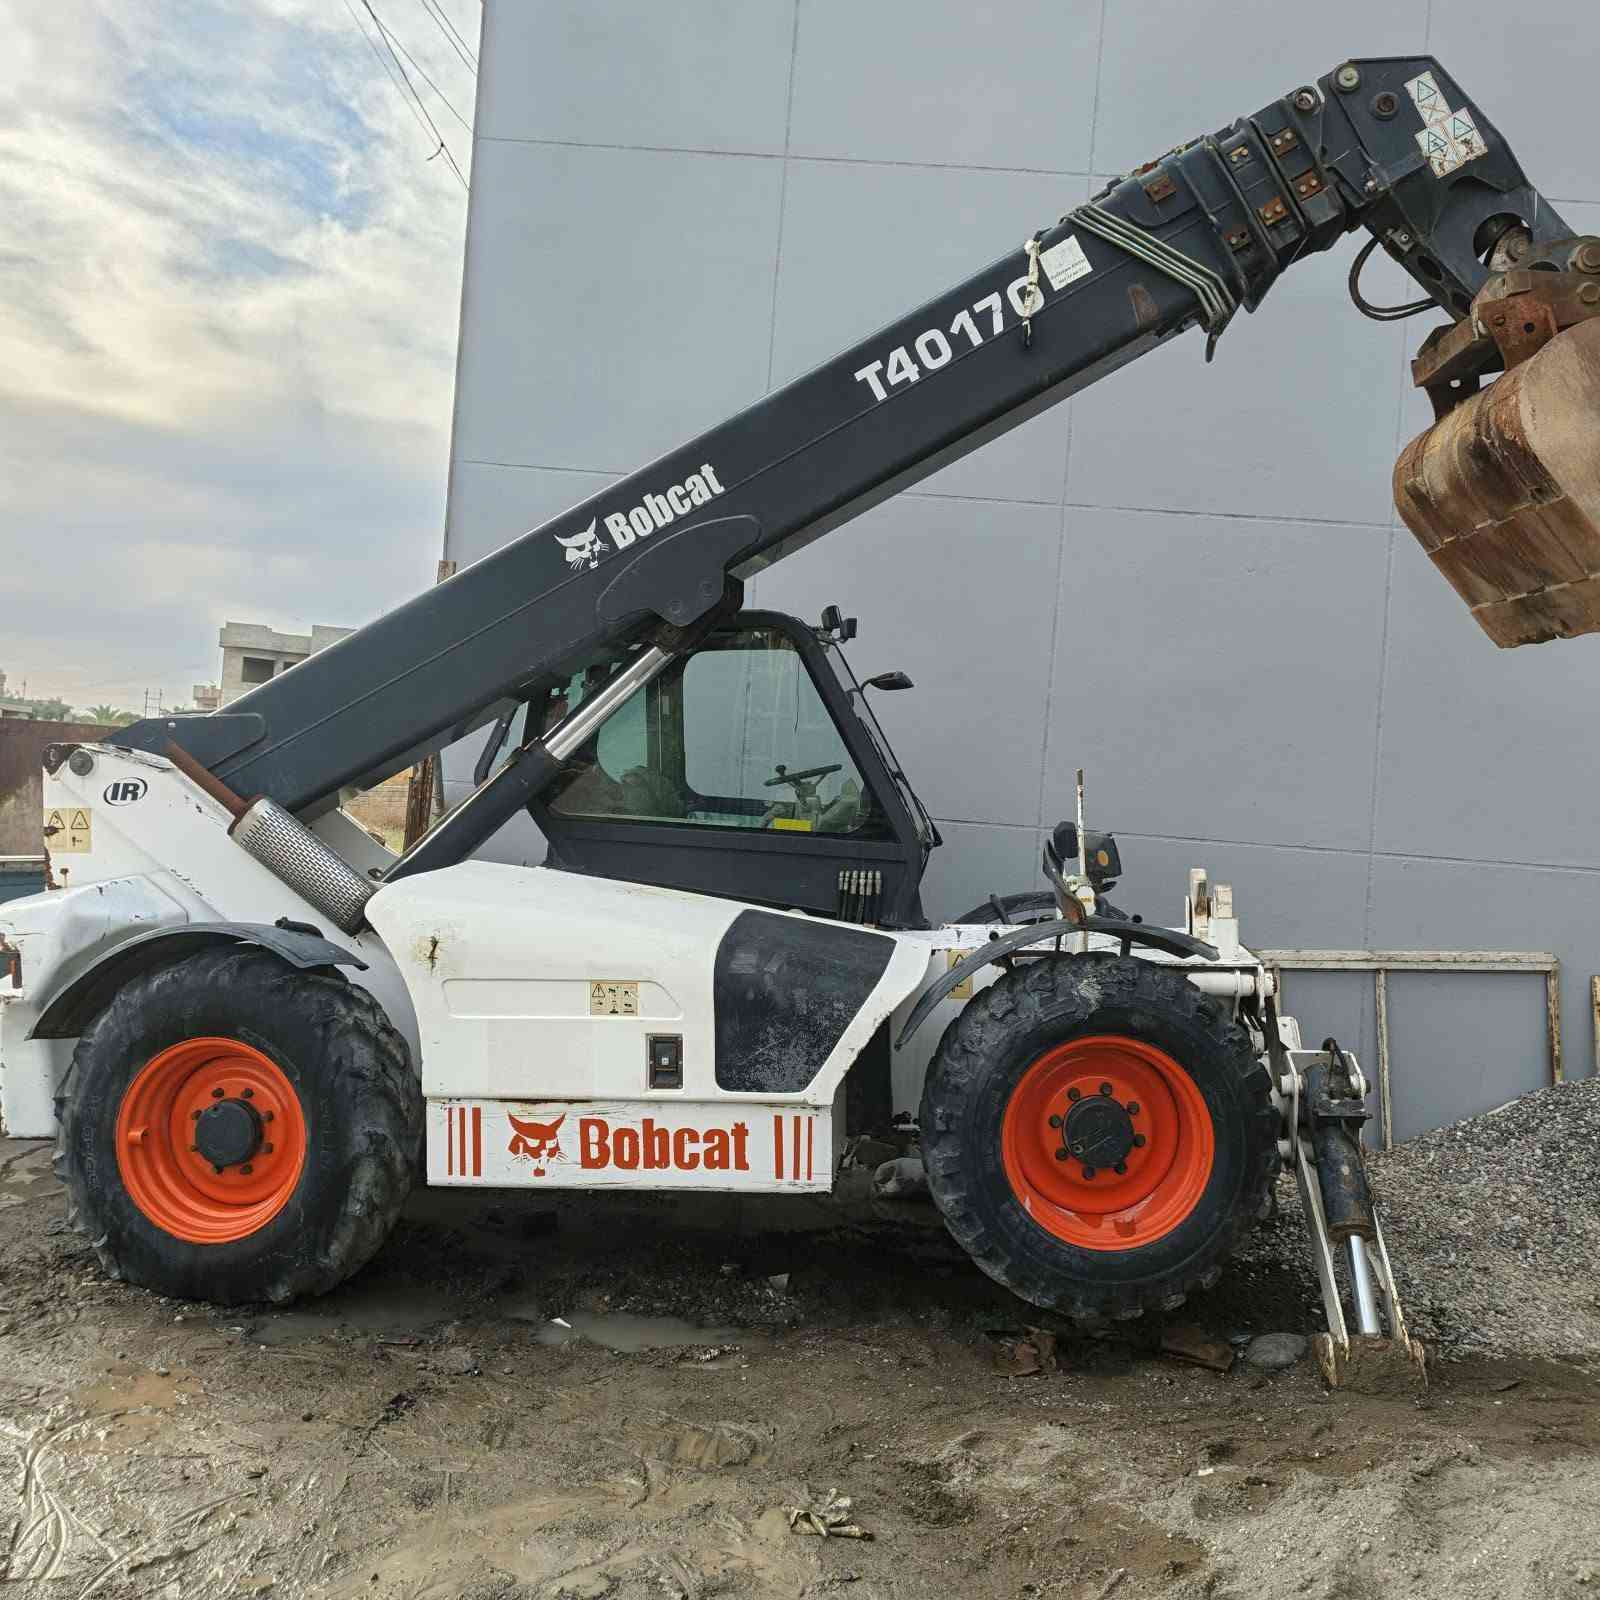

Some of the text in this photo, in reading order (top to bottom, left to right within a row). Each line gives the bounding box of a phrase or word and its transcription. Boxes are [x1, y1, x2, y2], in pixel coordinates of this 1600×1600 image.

[854, 276, 1045, 401] T40170
[603, 463, 725, 550] Bobcat
[110, 783, 140, 801] IR
[579, 1118, 750, 1170] Bobcat
